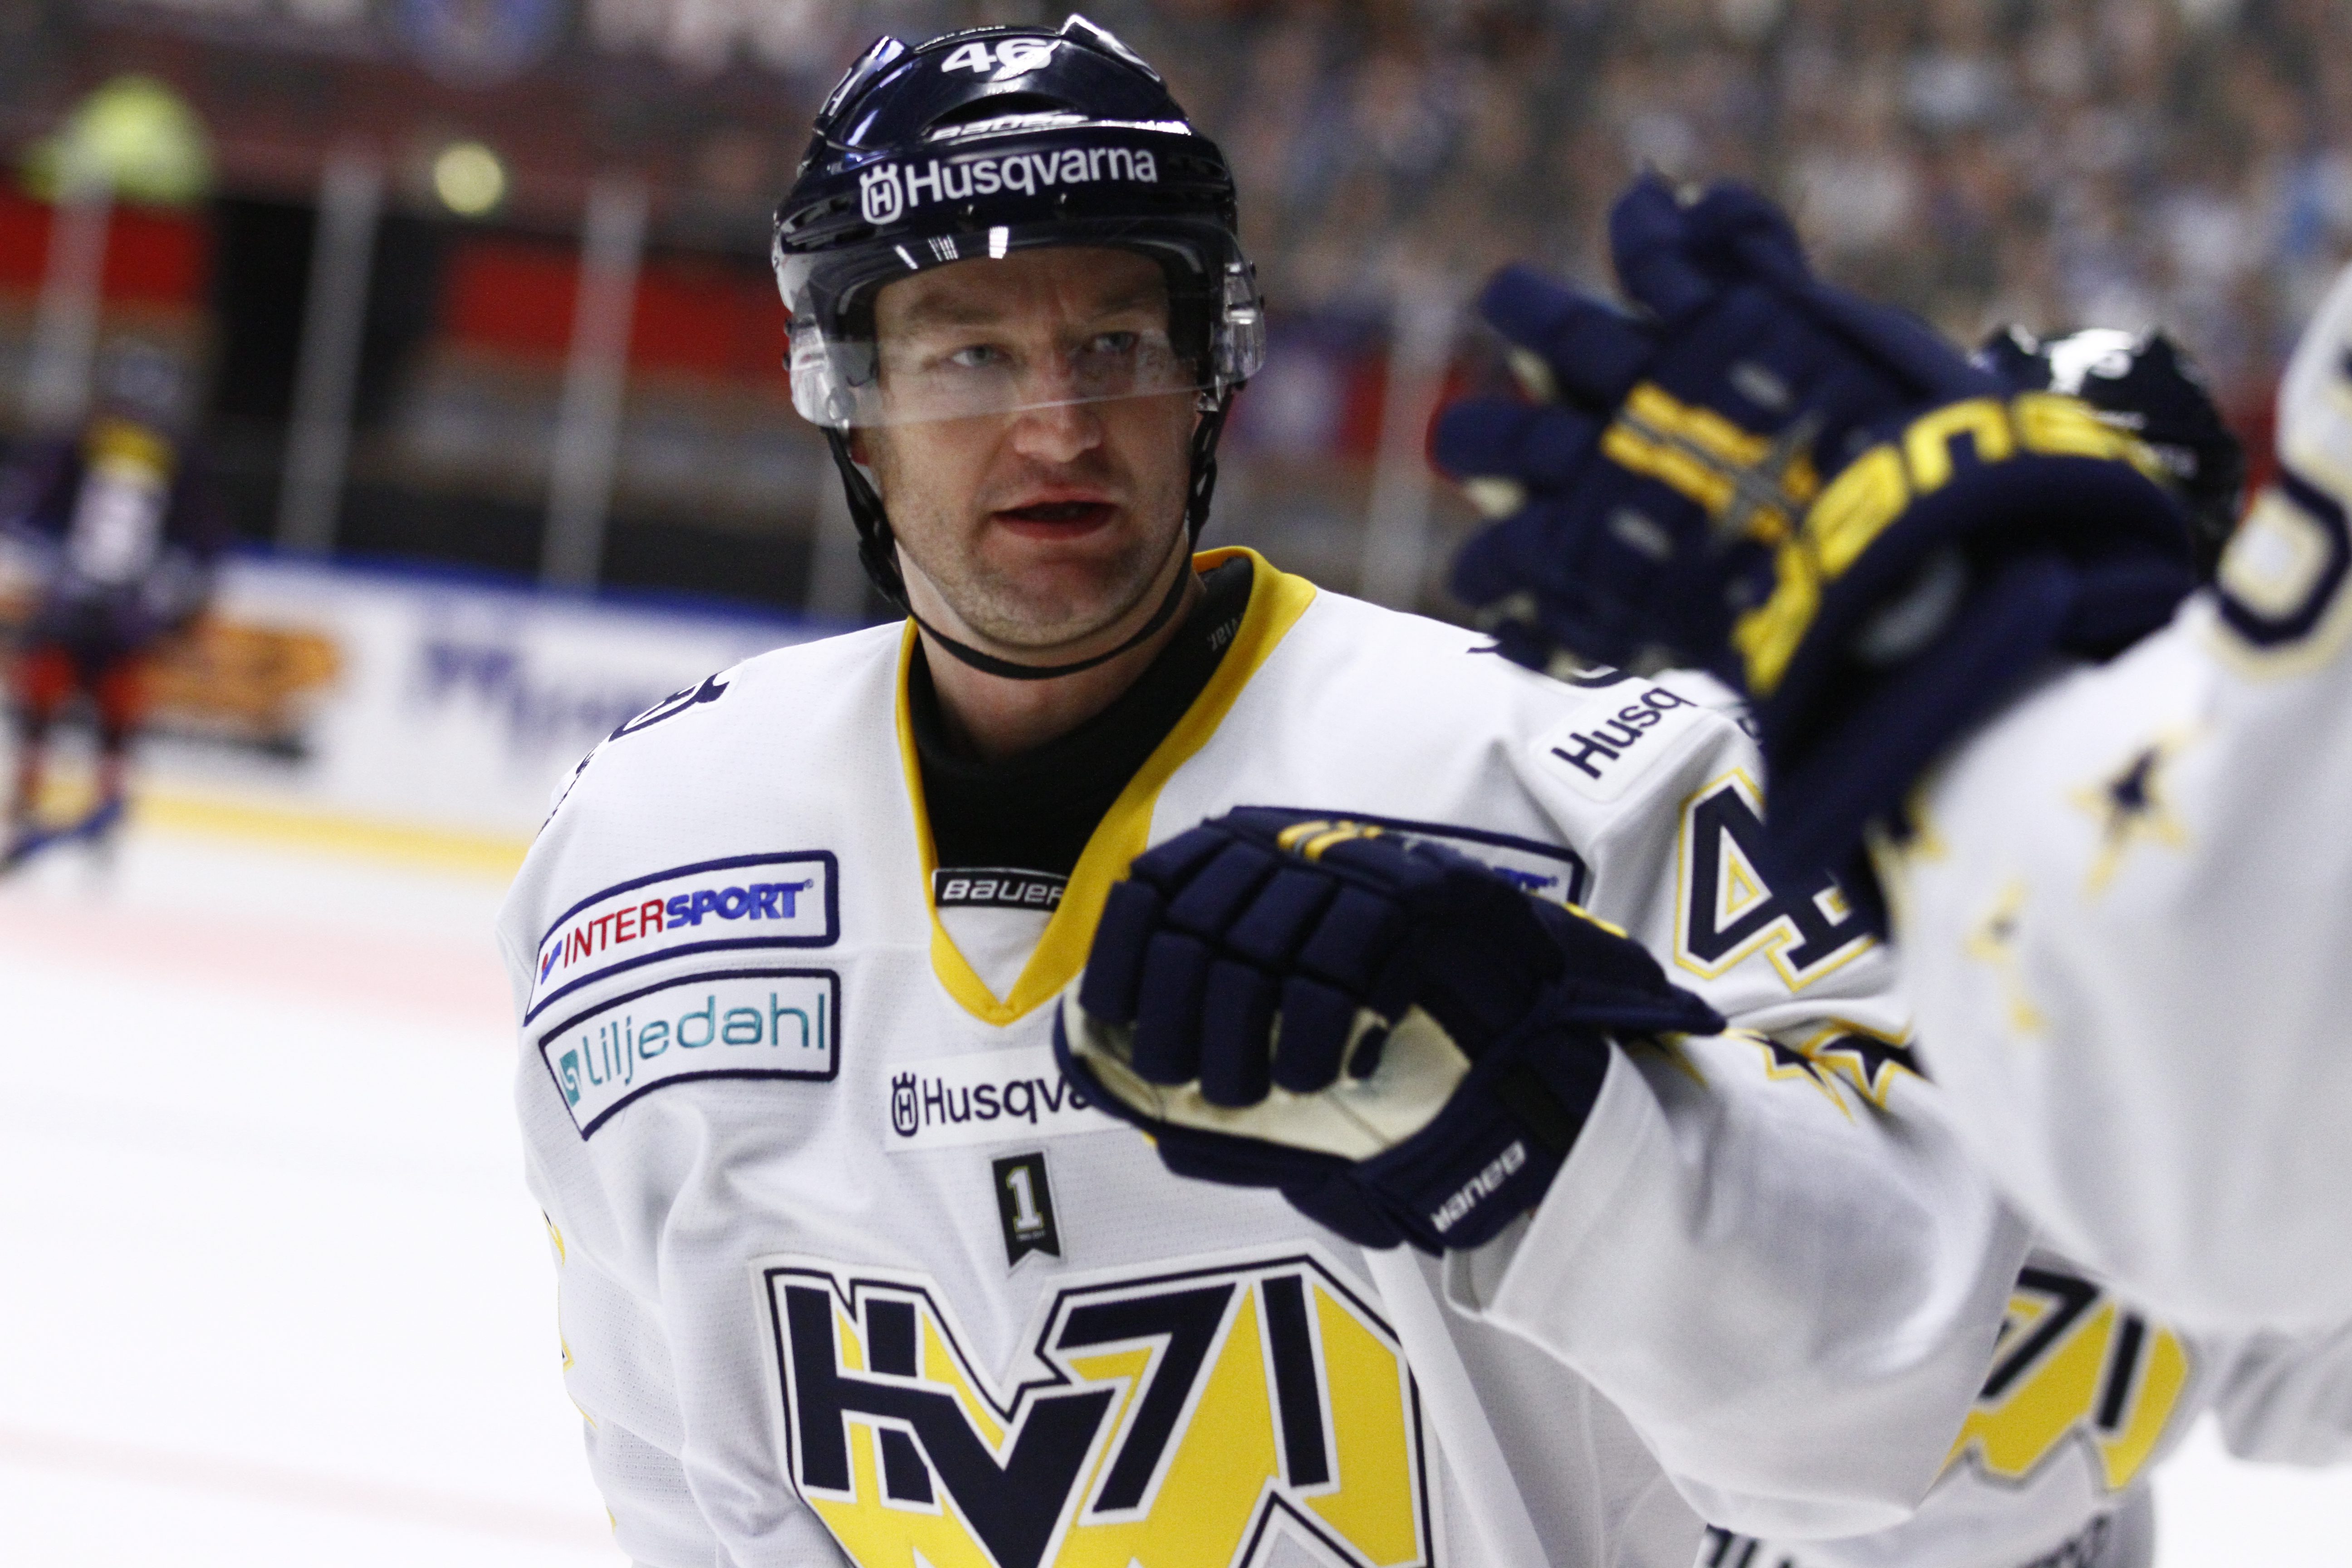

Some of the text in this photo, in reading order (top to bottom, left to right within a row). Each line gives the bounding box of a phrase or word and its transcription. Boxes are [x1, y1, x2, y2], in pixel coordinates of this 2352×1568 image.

[941, 38, 1051, 74] 46
[906, 147, 1158, 207] Husqvarna
[1551, 687, 1699, 780] Husq
[564, 881, 806, 968] INTERSPORT
[1005, 1164, 1044, 1232] 1
